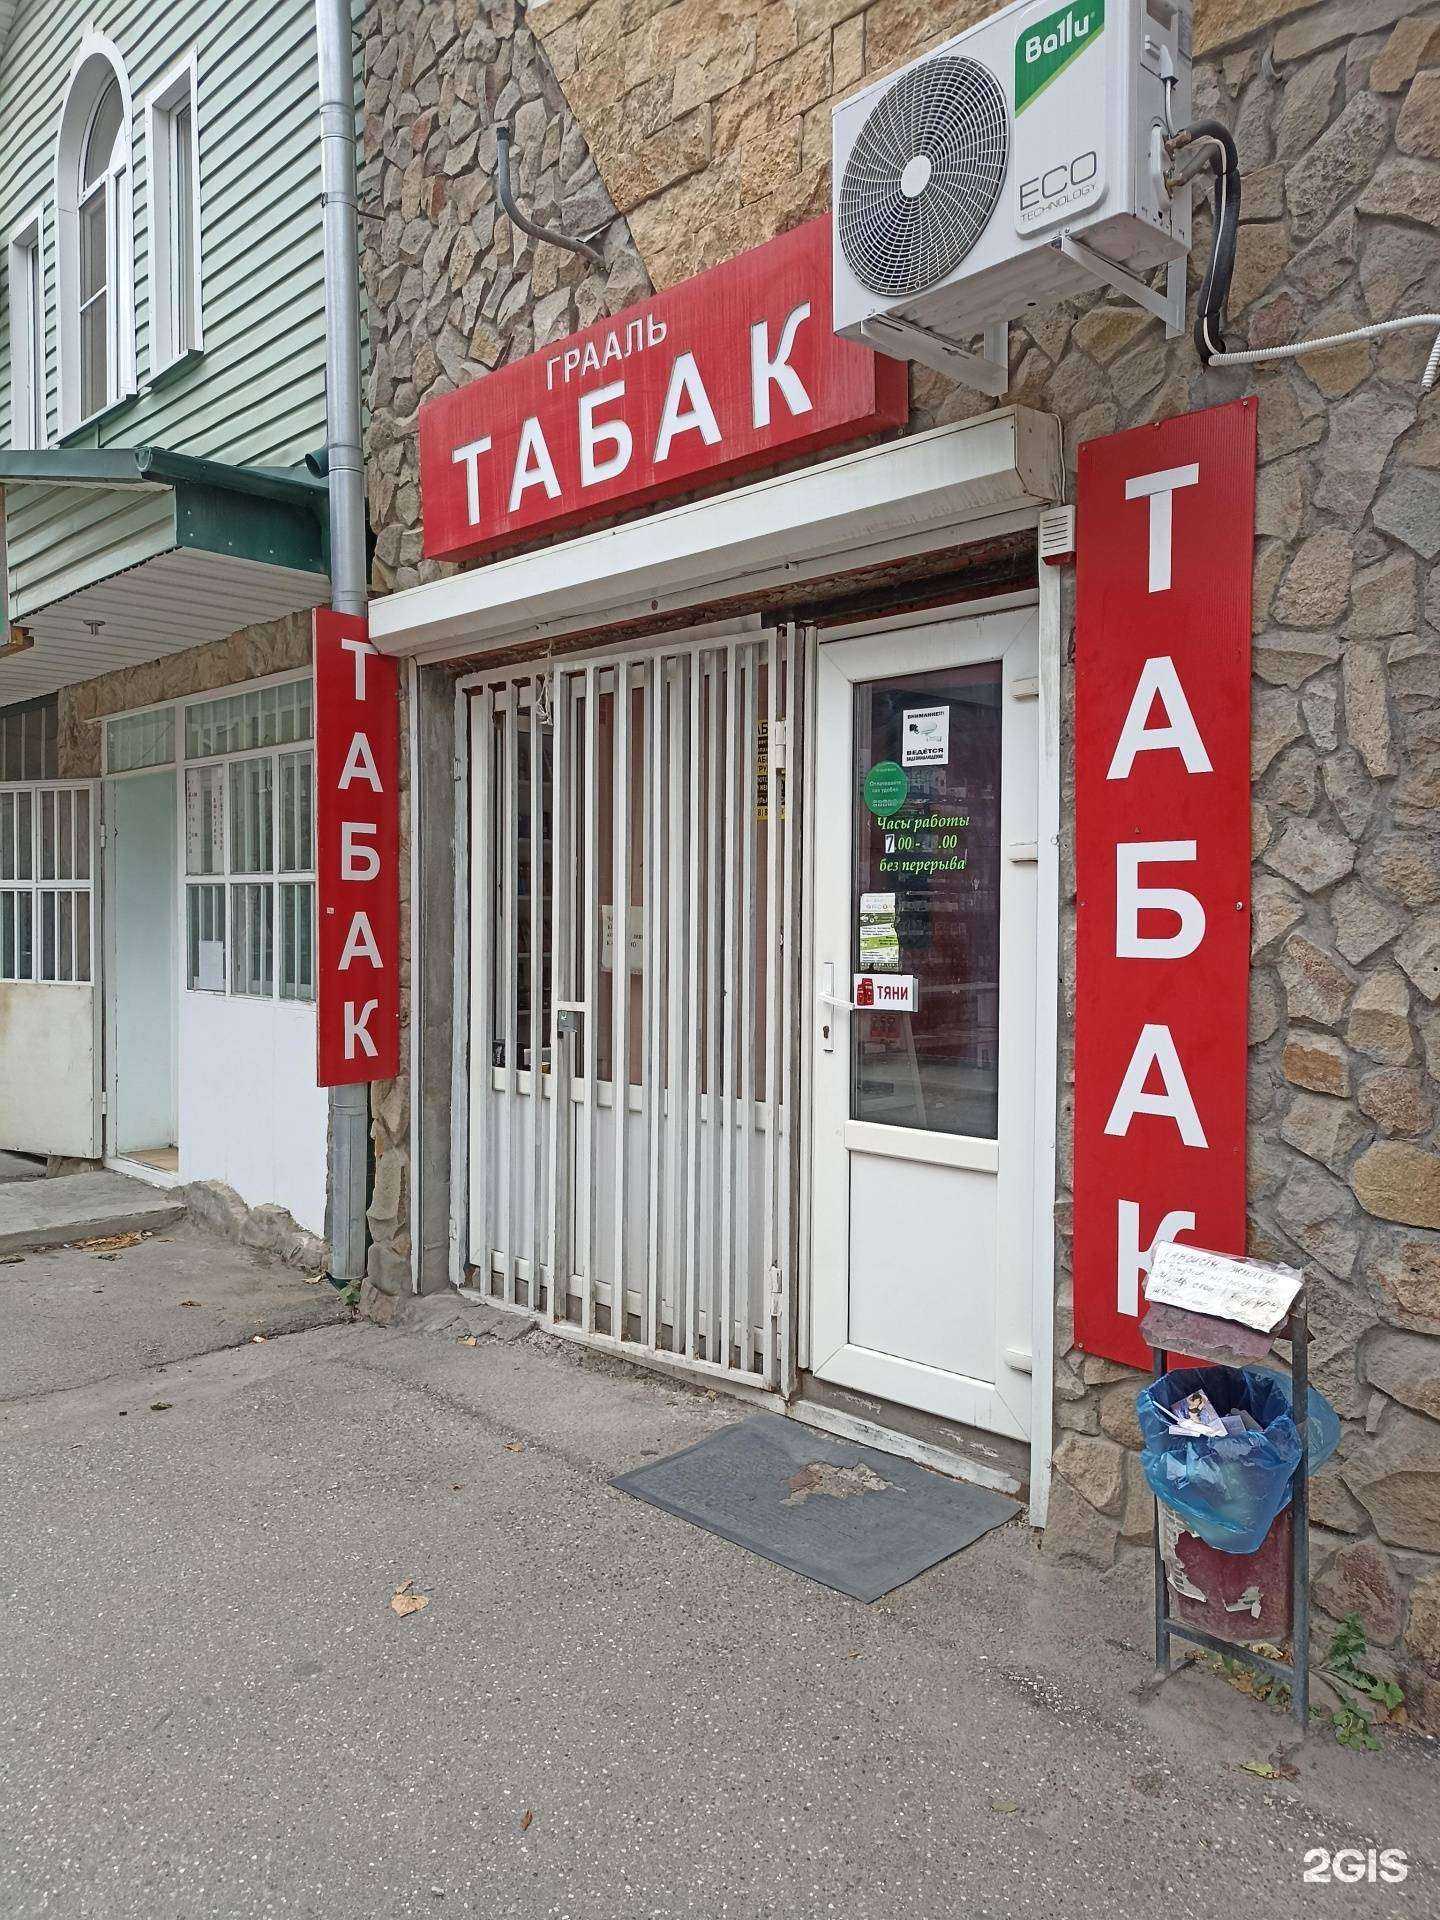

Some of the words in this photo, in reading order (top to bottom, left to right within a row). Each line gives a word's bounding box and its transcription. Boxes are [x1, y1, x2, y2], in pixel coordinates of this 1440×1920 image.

[1025, 11, 1089, 64] Ballu
[1019, 150, 1097, 211] ECO
[1020, 183, 1097, 223] TECHNOLOGY
[547, 312, 668, 391] ГРААЛЬ
[452, 300, 814, 526] ТАБАК
[338, 638, 384, 1060] ТАБАК
[876, 816, 911, 831] Часы
[914, 813, 970, 833] работы
[879, 857, 899, 872] без
[901, 855, 966, 876] перерыва
[1103, 462, 1214, 1319] ТАБАК
[876, 985, 909, 1001] ТЯНИ
